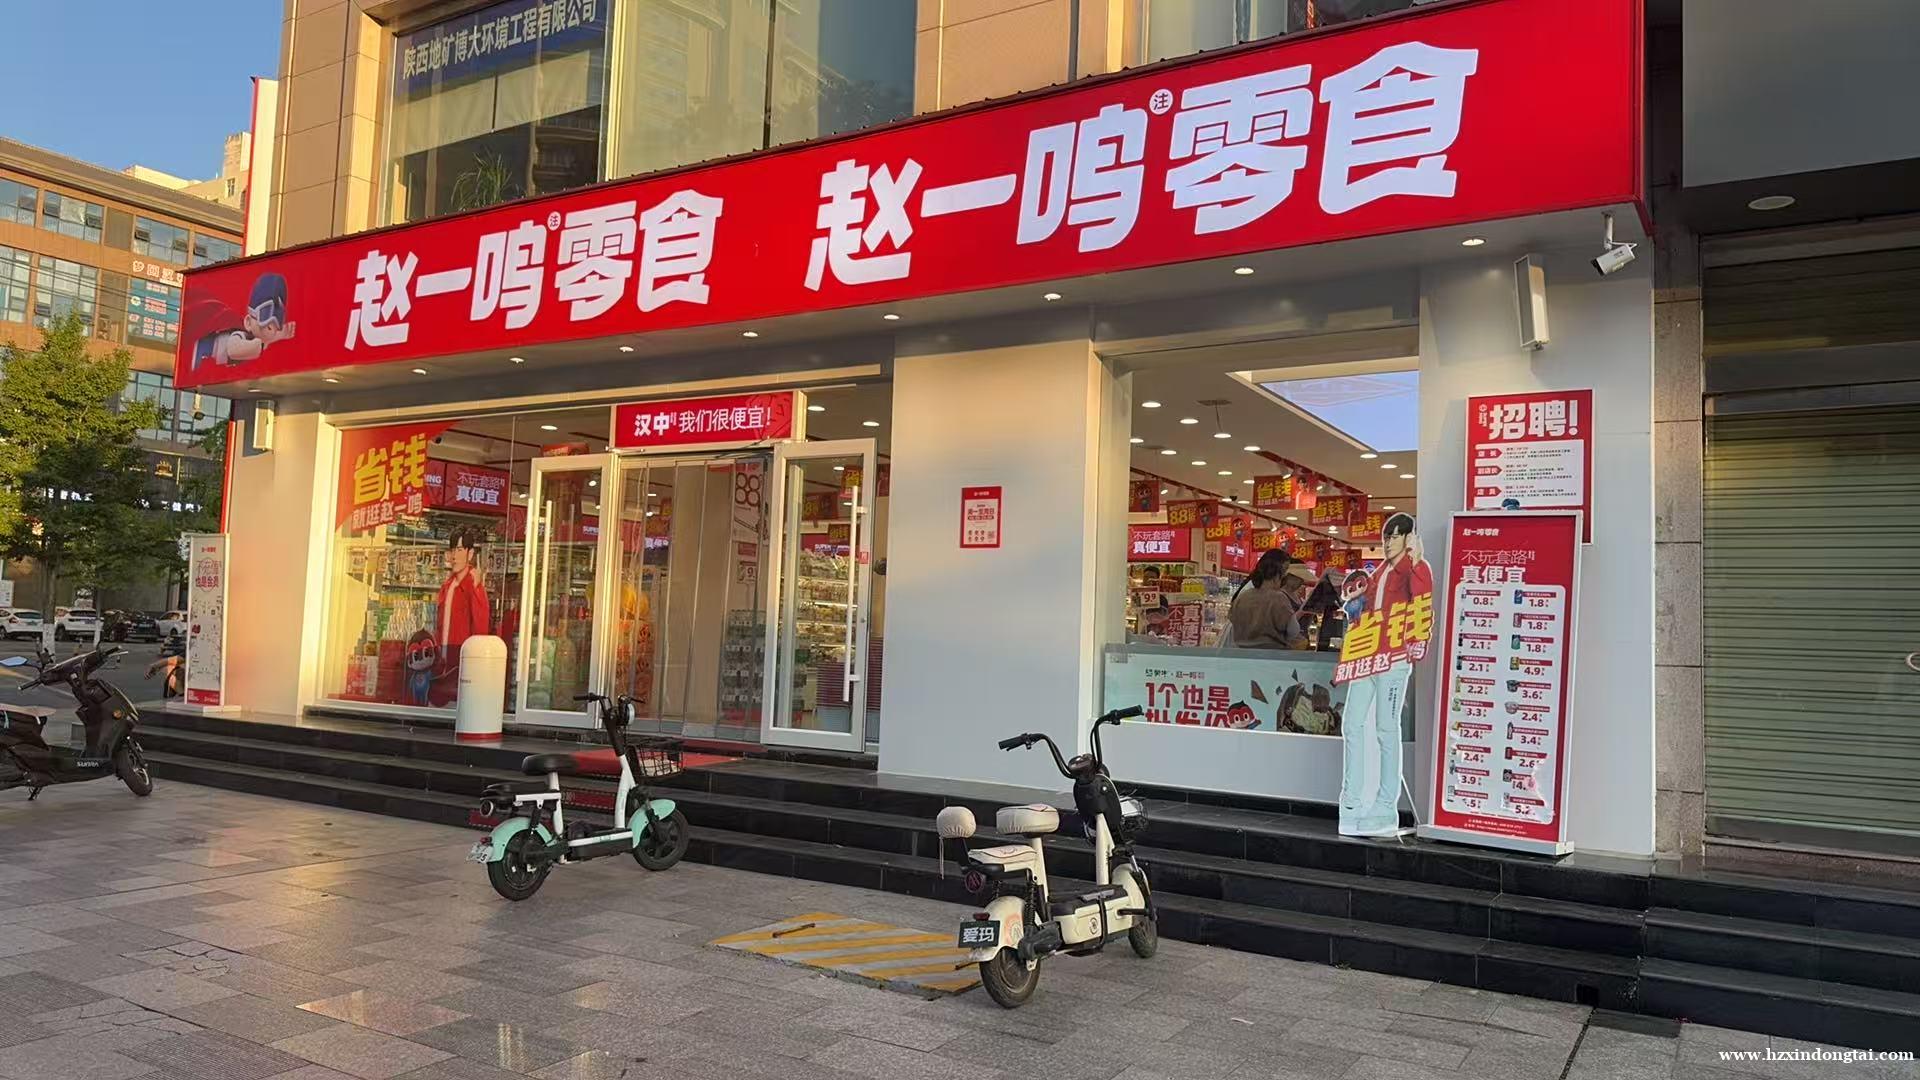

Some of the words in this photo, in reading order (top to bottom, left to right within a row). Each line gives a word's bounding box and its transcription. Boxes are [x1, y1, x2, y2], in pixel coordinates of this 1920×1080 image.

[403, 0, 596, 80] 陕西地矿博大环境工程有限公司
[354, 433, 427, 505] 省钱
[456, 486, 500, 505] 真便宜
[1133, 541, 1171, 554] 真便宜
[1460, 565, 1526, 585] 真便宜
[1341, 592, 1432, 662] 省钱
[1145, 682, 1230, 712] 1个也是
[963, 927, 994, 943] 爱玛
